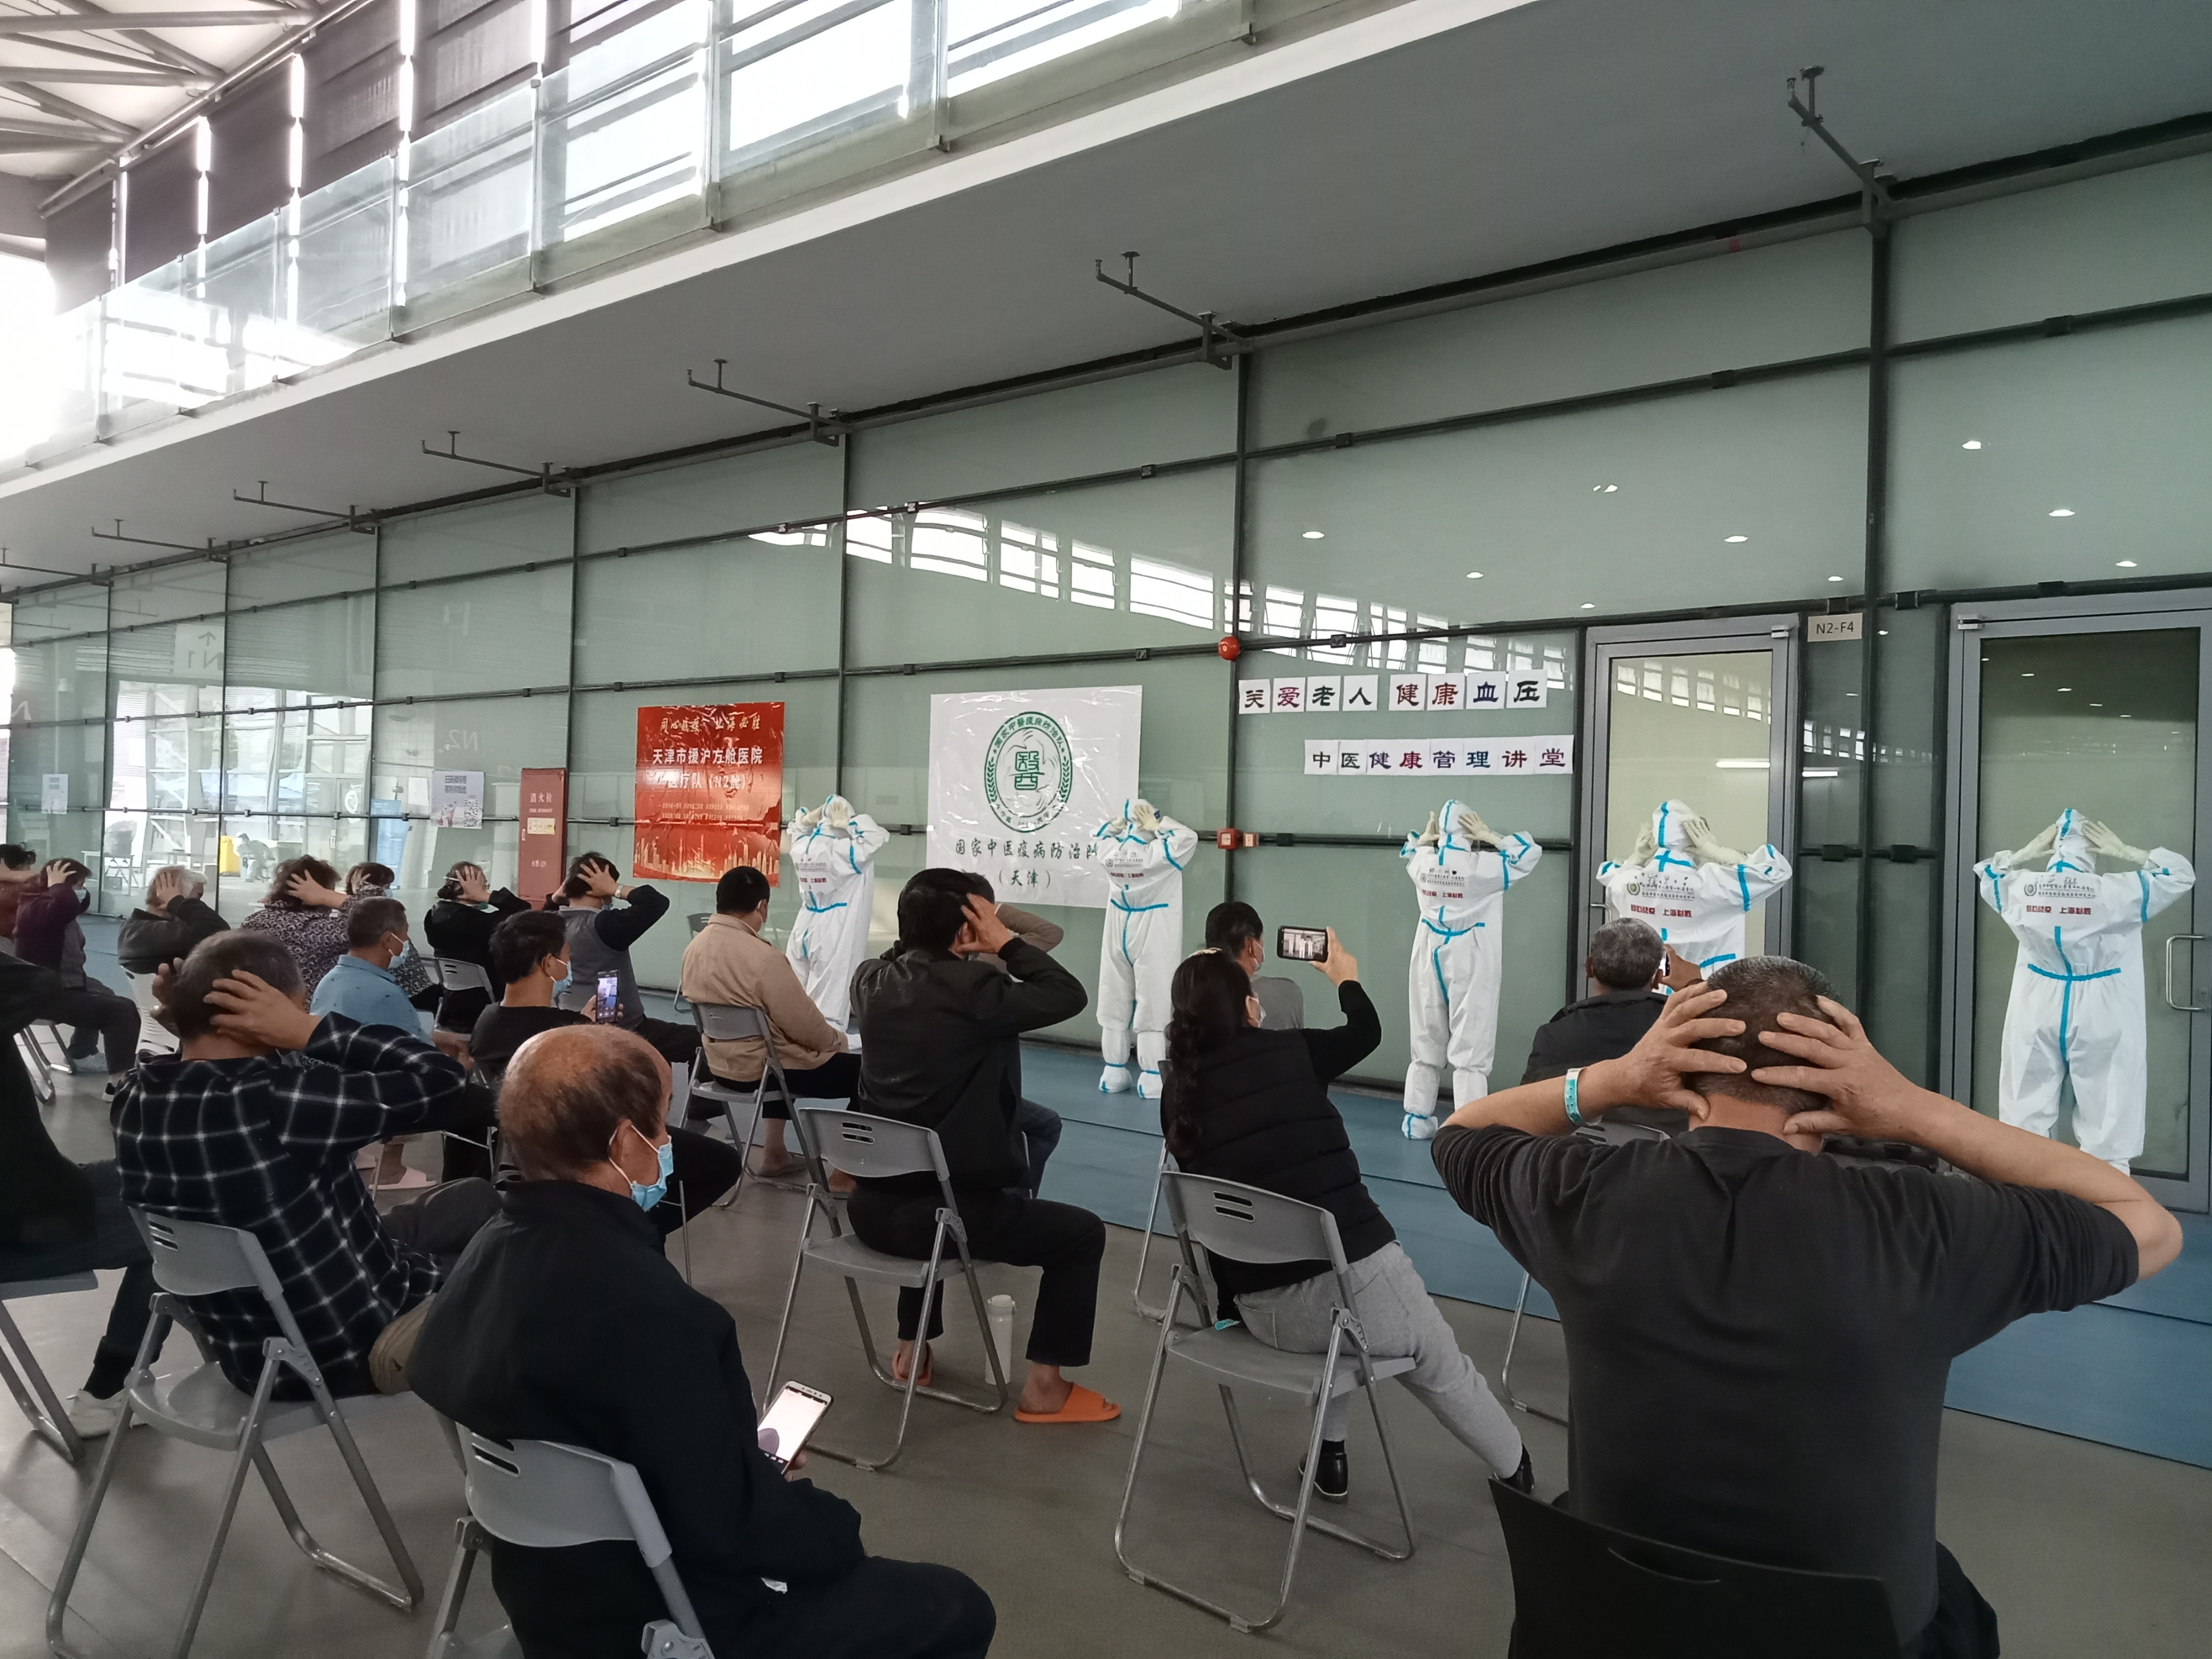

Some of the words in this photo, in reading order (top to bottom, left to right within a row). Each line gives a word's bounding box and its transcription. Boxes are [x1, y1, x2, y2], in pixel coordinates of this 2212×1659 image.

[1816, 621, 1854, 634] N2-F4
[1244, 685, 1373, 708] 关爱老人
[1396, 680, 1541, 707] 健康血压
[653, 747, 763, 764] 天津市援沪方舱医院
[1312, 748, 1566, 769] 中医健康管理讲堂
[530, 792, 553, 803] 消火栓
[956, 838, 1097, 859] 国家中医疫病防治队
